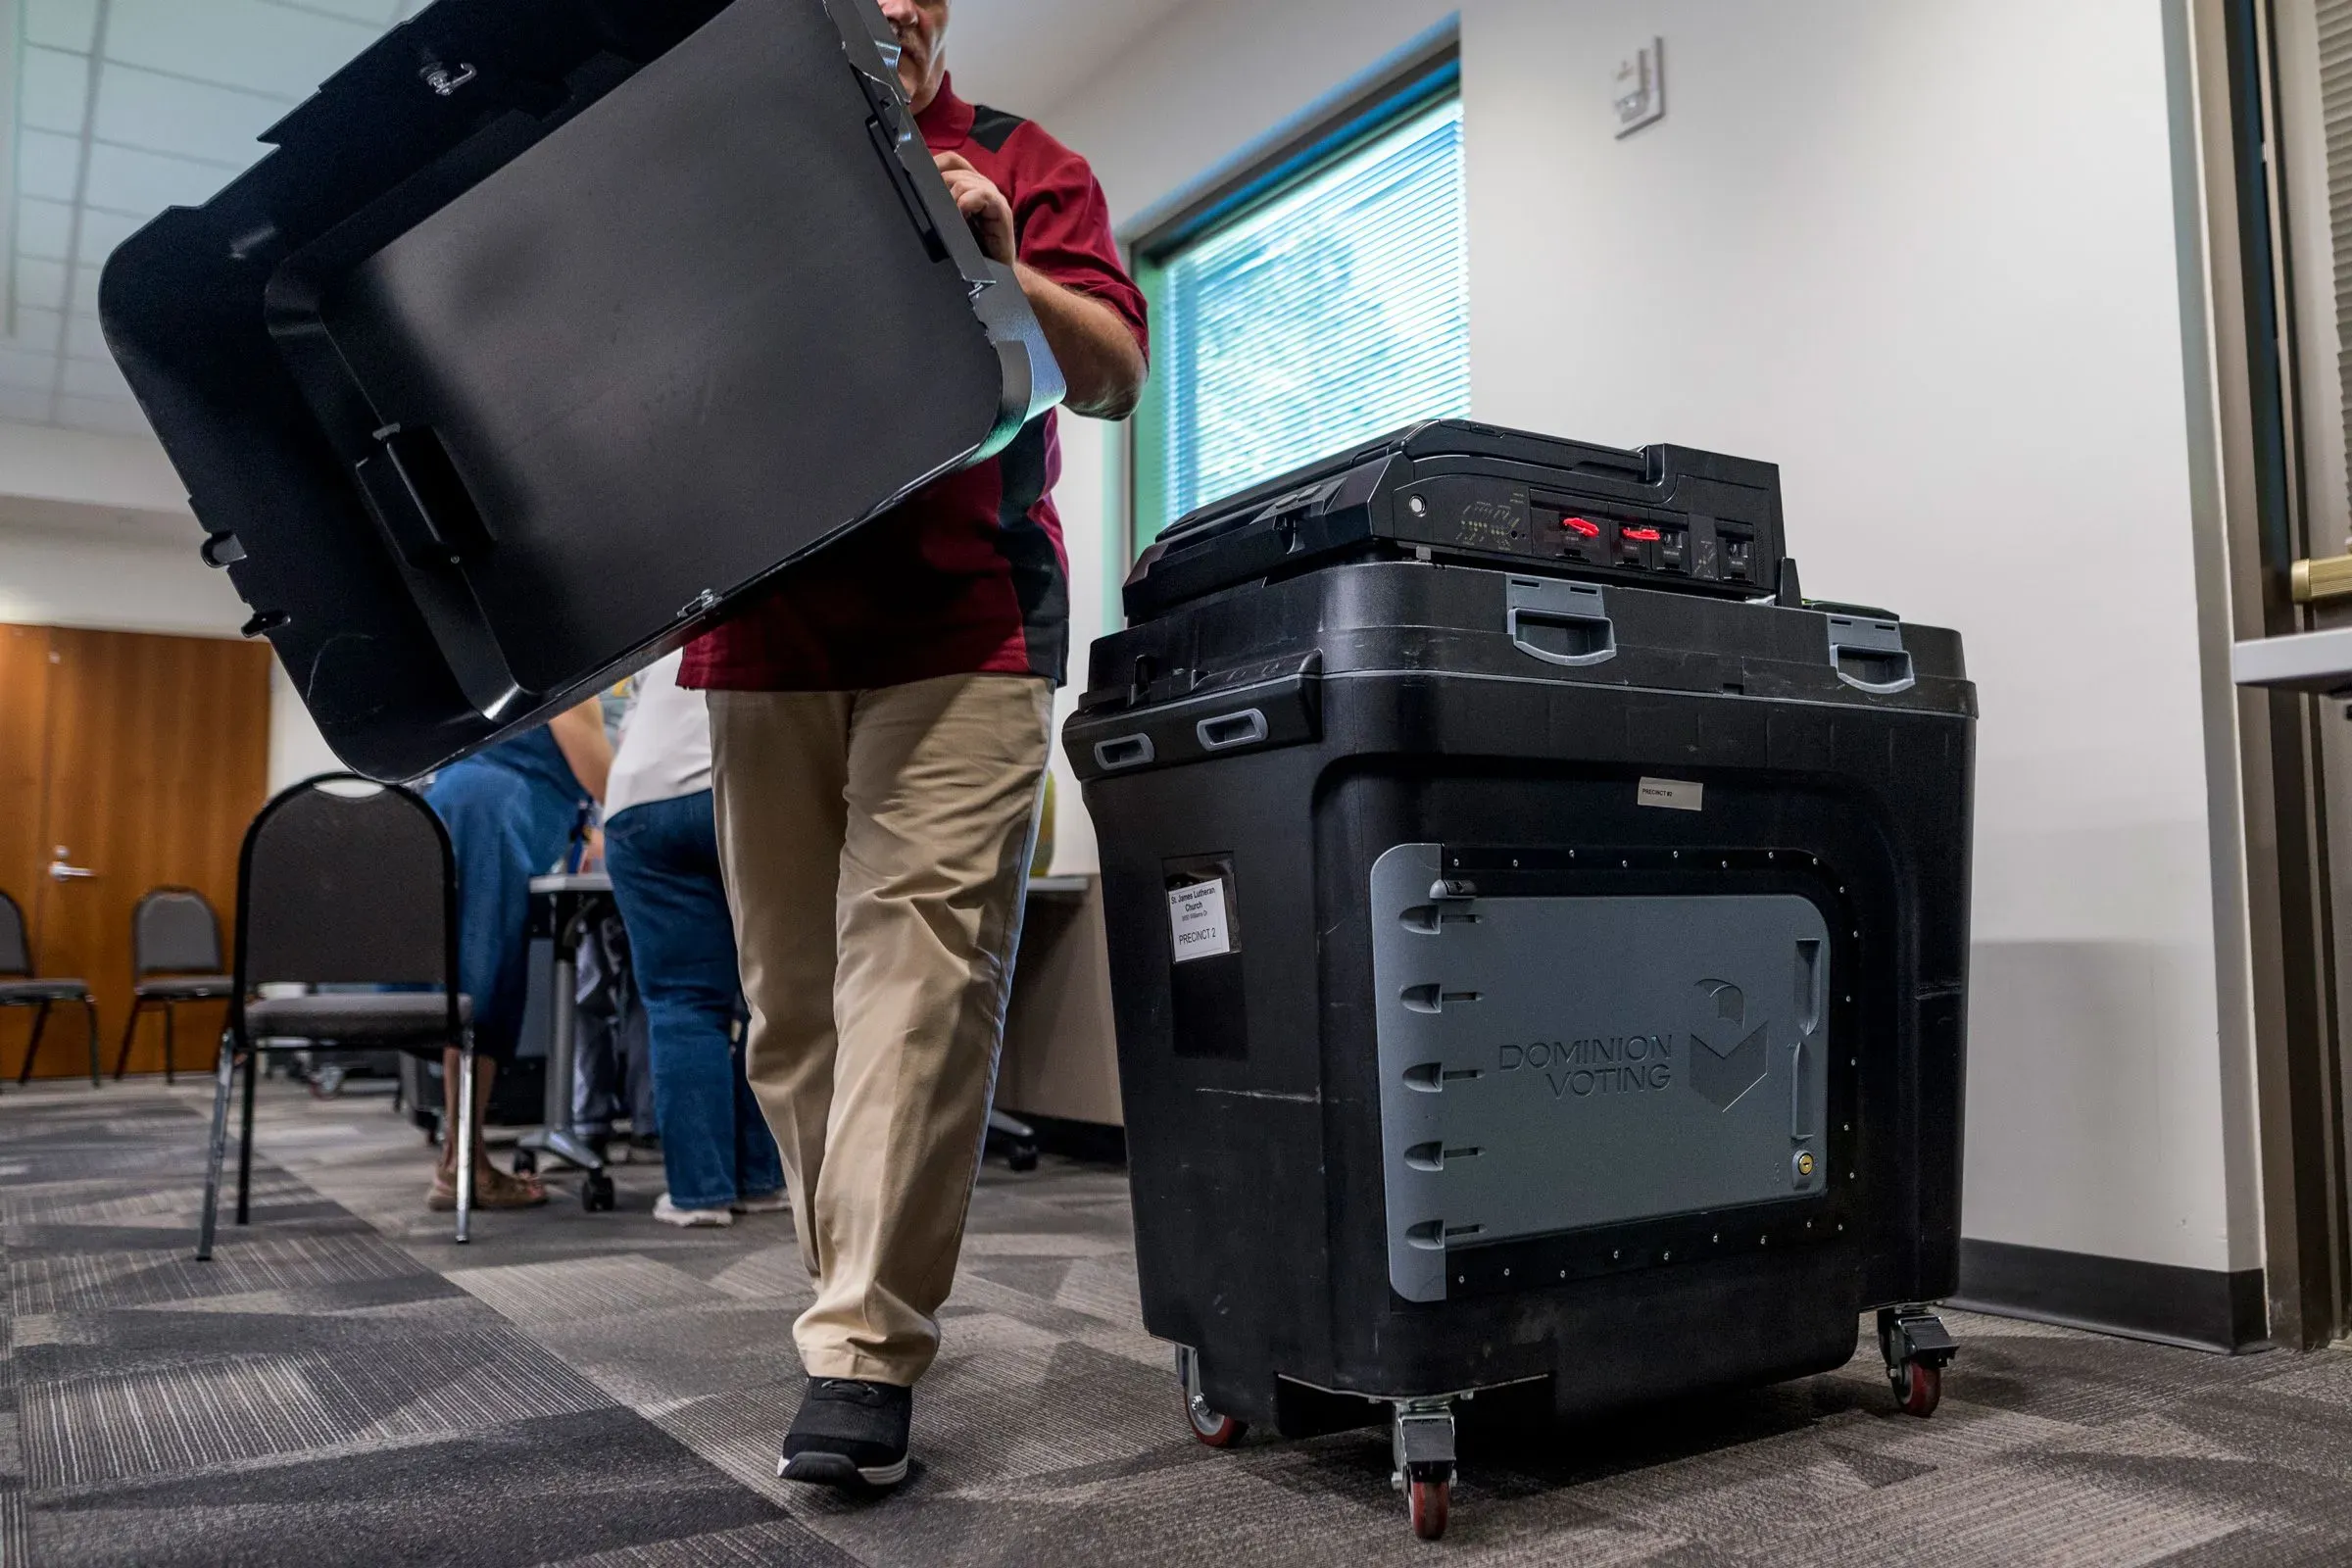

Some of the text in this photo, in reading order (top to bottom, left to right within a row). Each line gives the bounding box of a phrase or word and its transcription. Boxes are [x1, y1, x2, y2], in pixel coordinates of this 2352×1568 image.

[1179, 893, 1194, 903] James
[1194, 888, 1215, 899] Lutheran
[1185, 902, 1203, 912] Church
[1179, 927, 1216, 945] PRECINCT 2
[1499, 1034, 1672, 1072] DOMINION
[1545, 1063, 1671, 1100] VOTING
